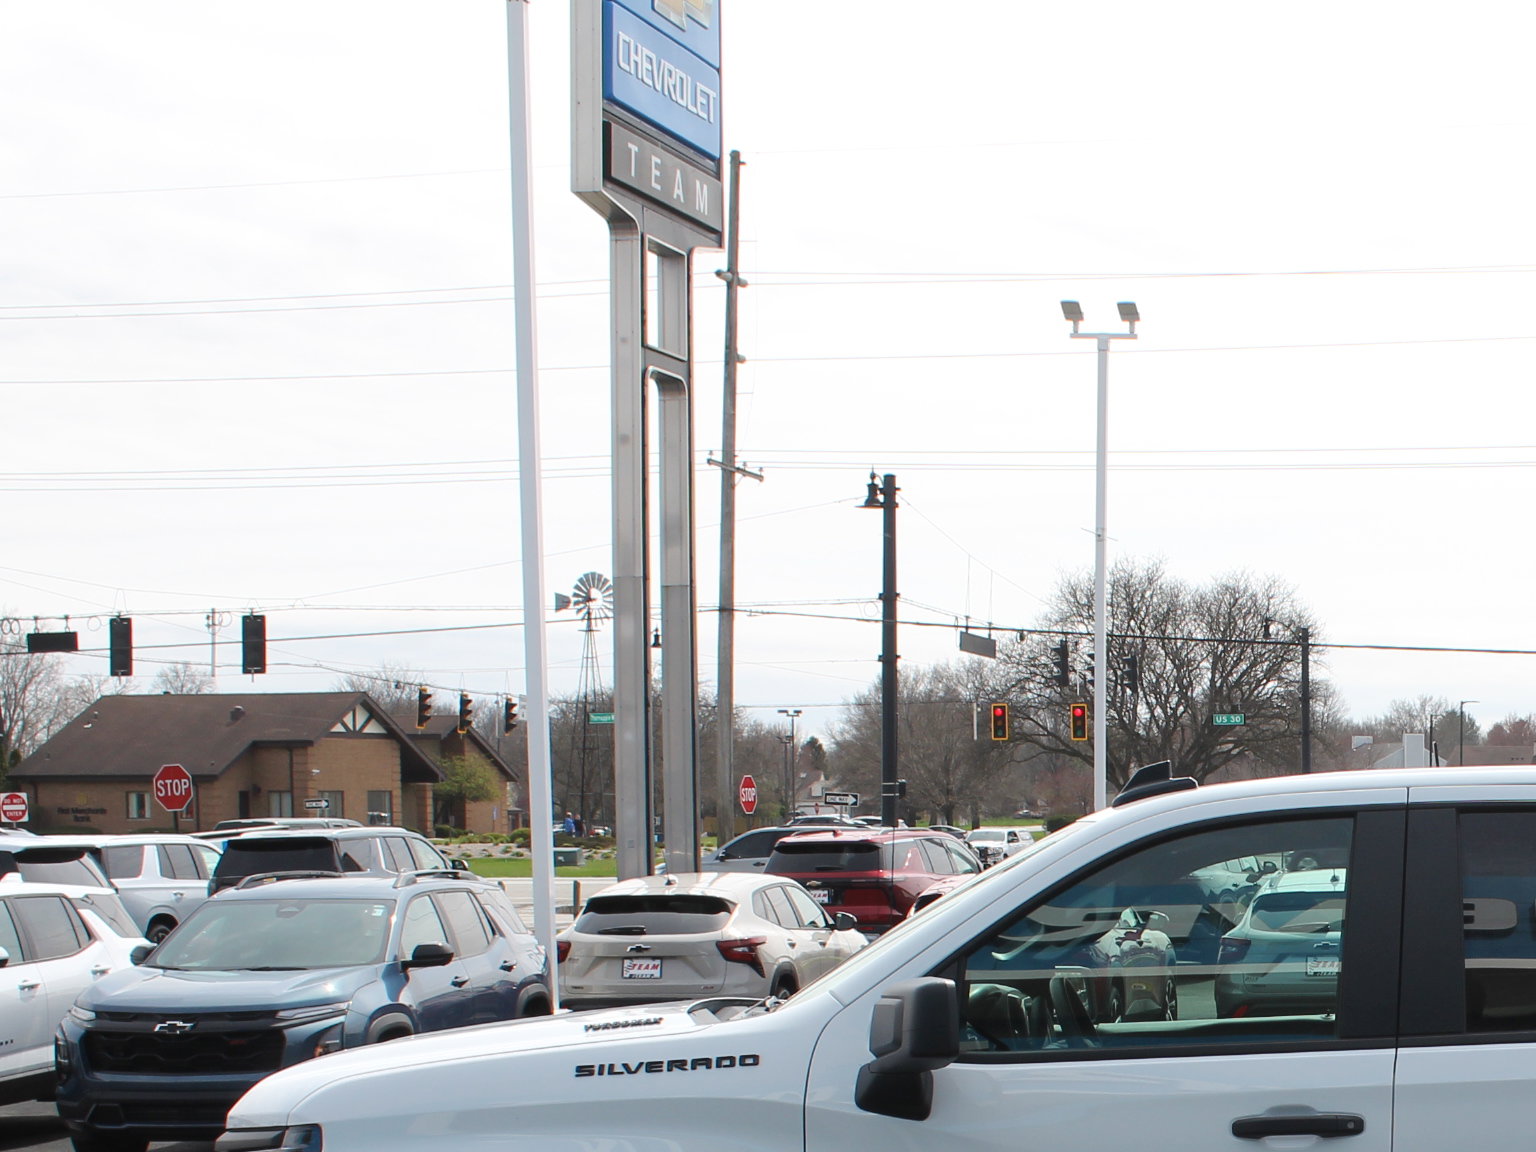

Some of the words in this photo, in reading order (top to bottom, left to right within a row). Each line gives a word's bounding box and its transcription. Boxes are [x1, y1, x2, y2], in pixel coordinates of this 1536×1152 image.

[617, 31, 716, 124] CHEVROLET
[627, 142, 708, 215] TEAM
[1215, 715, 1228, 723] US
[1230, 715, 1241, 723] 30
[157, 779, 189, 797] STOP
[741, 787, 756, 802] STOP
[575, 1054, 760, 1077] SILVERADO
